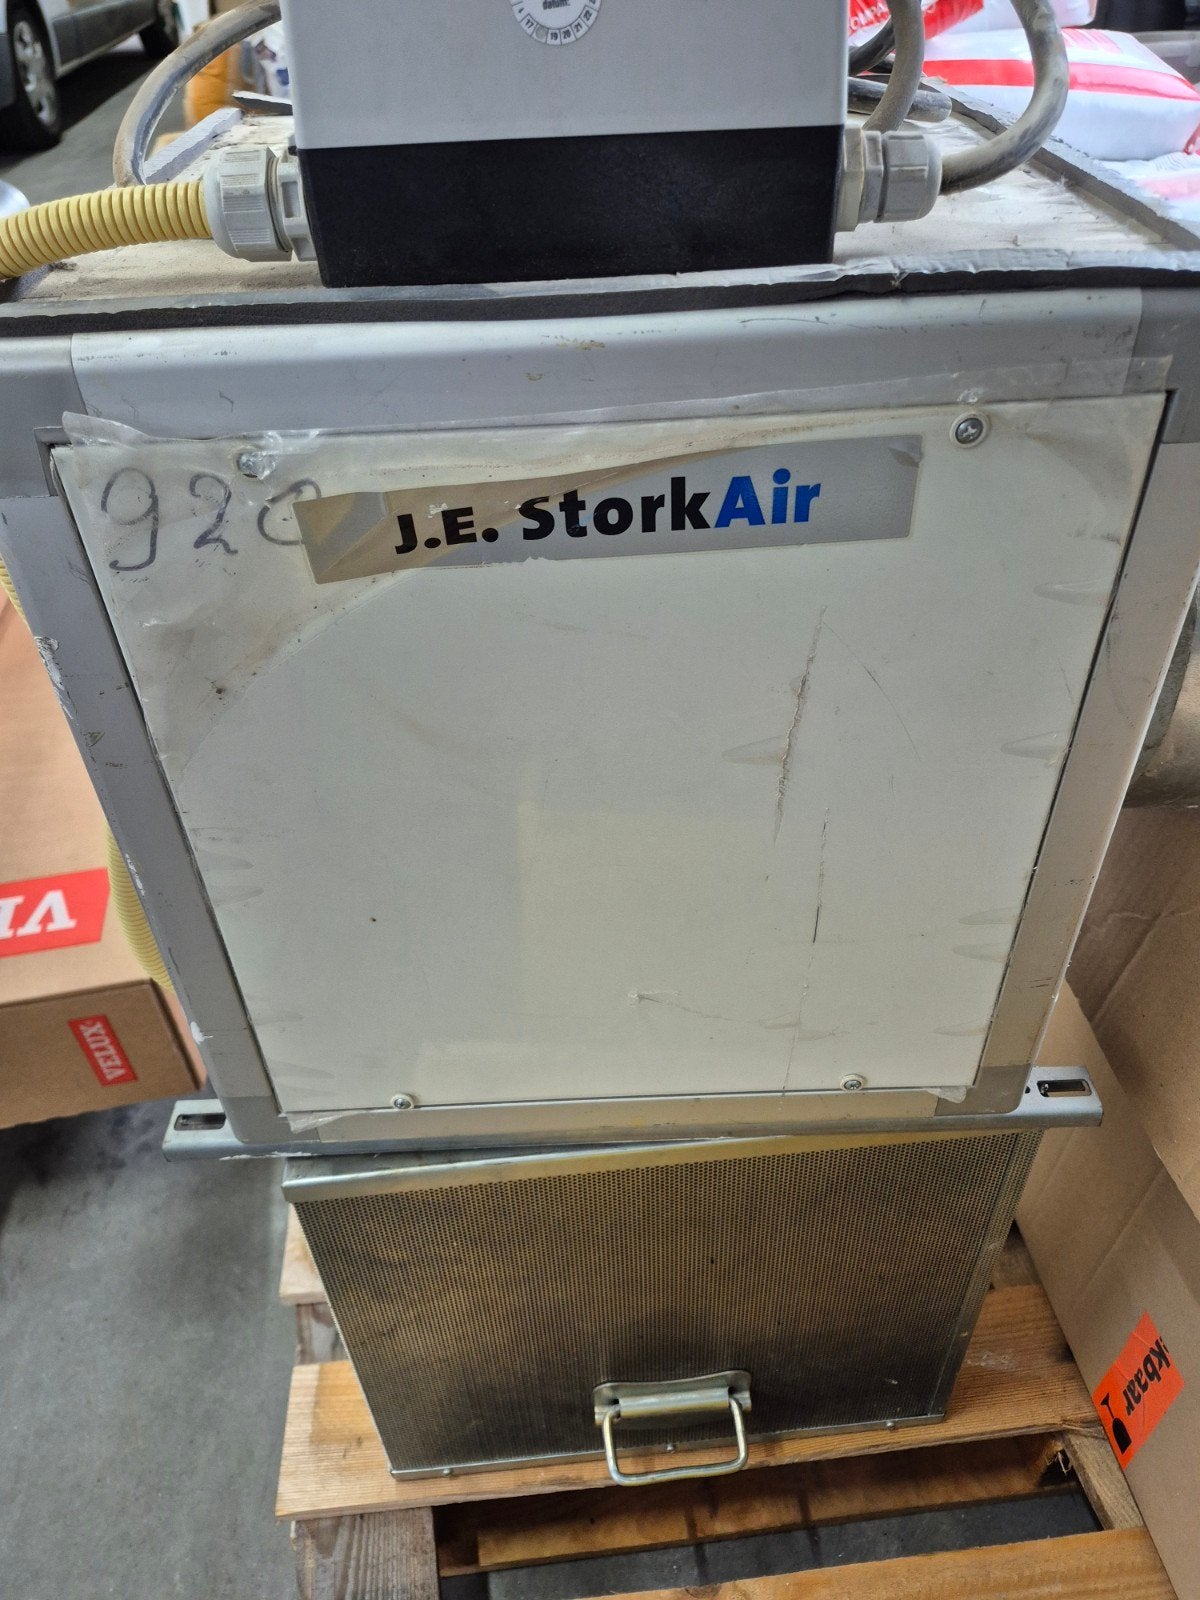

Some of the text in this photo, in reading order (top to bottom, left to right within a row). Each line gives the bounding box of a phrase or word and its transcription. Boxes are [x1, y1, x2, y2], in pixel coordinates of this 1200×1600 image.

[583, 9, 592, 21] 22
[525, 18, 534, 29] 17
[574, 22, 583, 32] 21
[550, 32, 558, 40] 19
[562, 29, 571, 39] 20
[394, 468, 821, 555] J.E. StorkAir
[78, 1019, 127, 1082] VELUX
